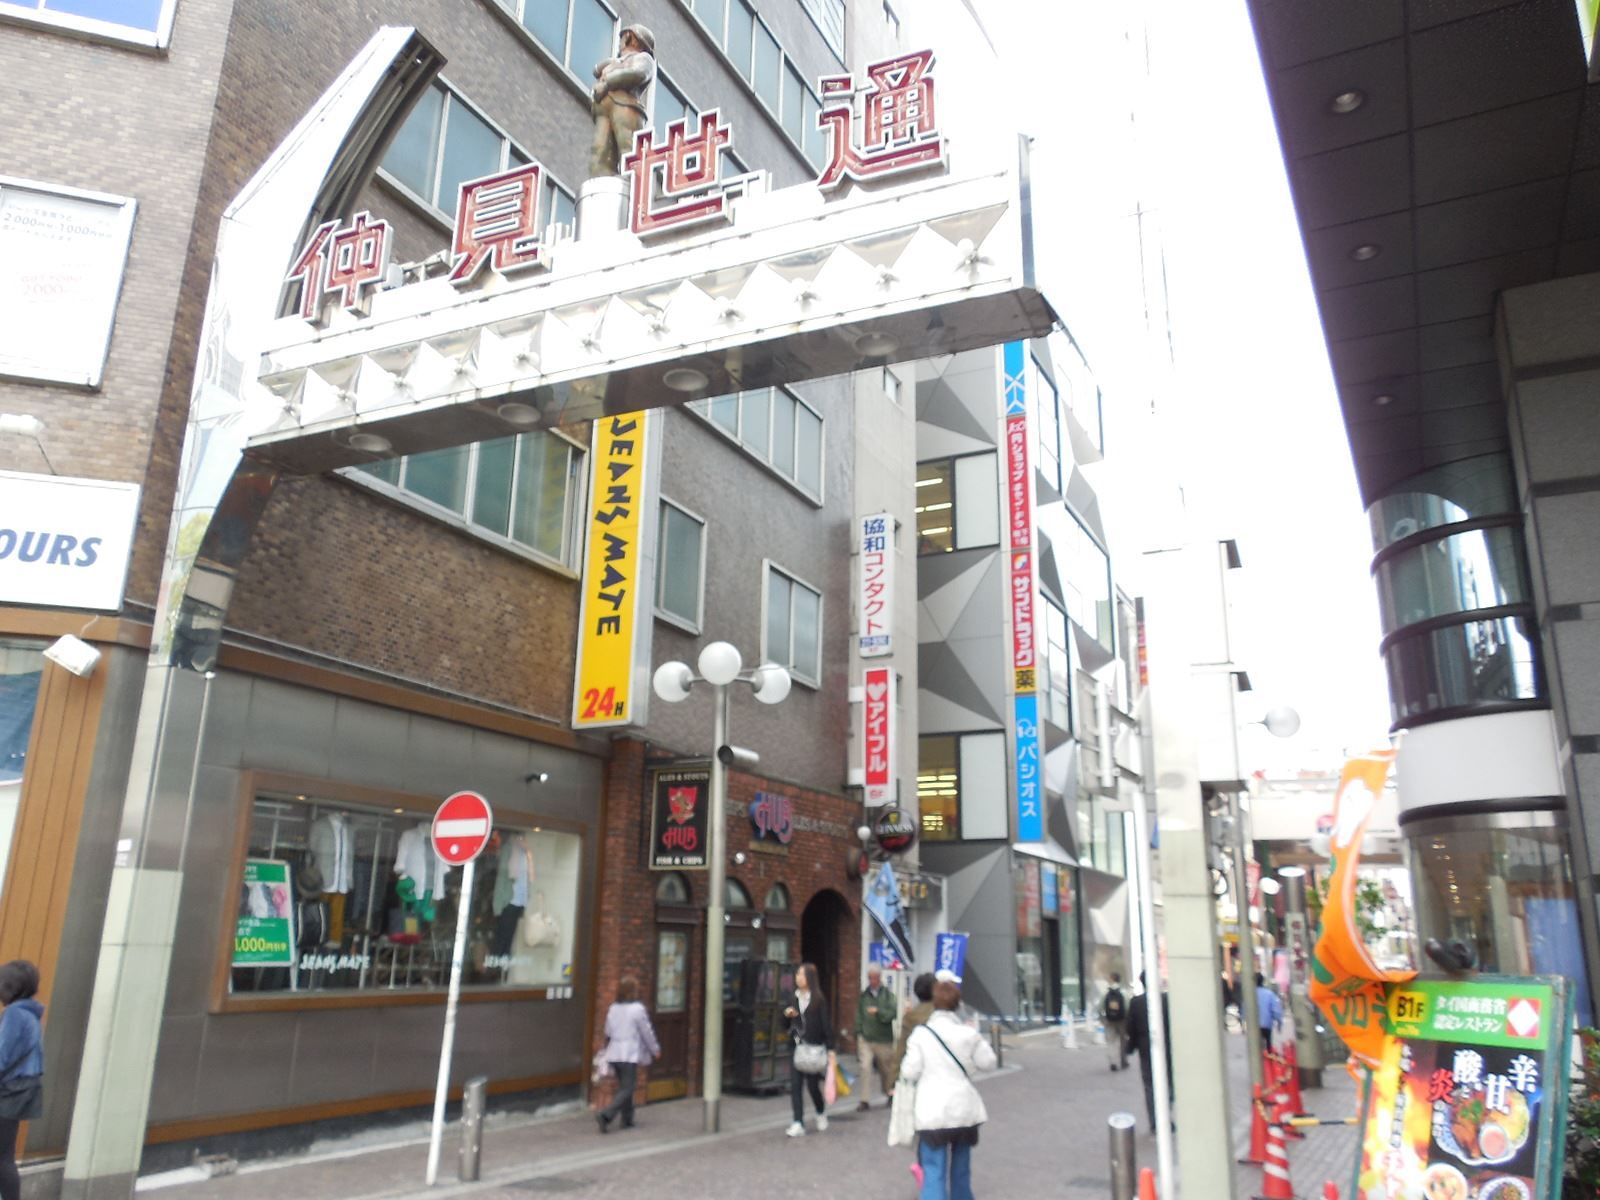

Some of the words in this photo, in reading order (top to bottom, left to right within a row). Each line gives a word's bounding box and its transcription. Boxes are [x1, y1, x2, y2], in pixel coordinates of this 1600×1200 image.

[285, 48, 950, 328] 仲見世通
[594, 416, 637, 526] JEANS
[0, 528, 103, 567] OURS
[596, 532, 627, 636] MATE
[863, 518, 886, 636] 協和コンタクト
[1014, 575, 1033, 668] サンドラッグ
[868, 702, 887, 773] アイフル
[1018, 743, 1038, 818] パシオス
[662, 825, 698, 851] HUB
[1396, 996, 1425, 1018] B1F
